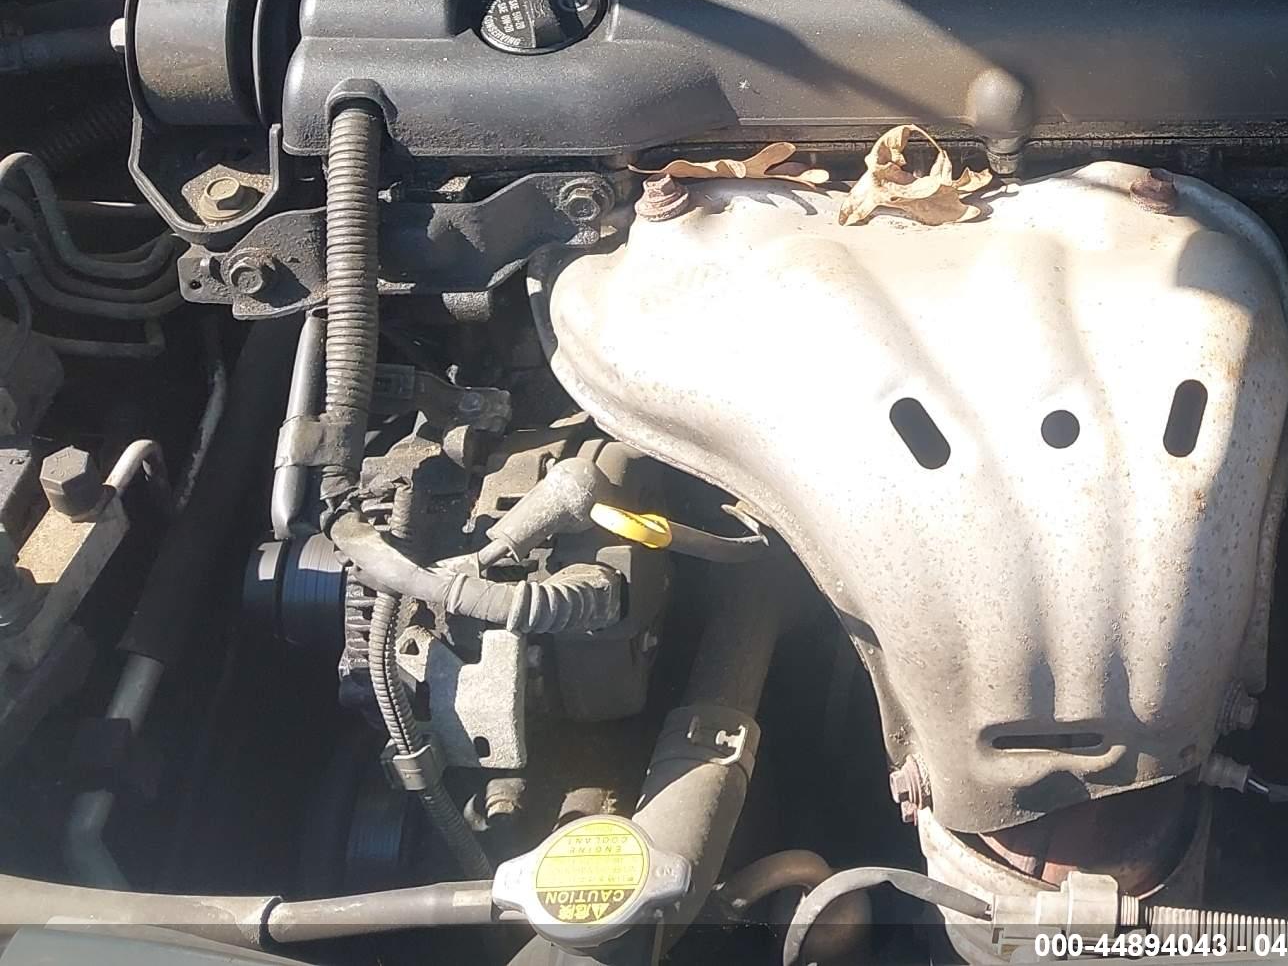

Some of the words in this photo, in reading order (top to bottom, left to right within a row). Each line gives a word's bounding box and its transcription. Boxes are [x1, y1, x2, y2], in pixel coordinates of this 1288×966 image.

[483, 15, 521, 46] CONSERVING
[545, 891, 625, 904] CAUTION
[558, 905, 592, 920] 危険
